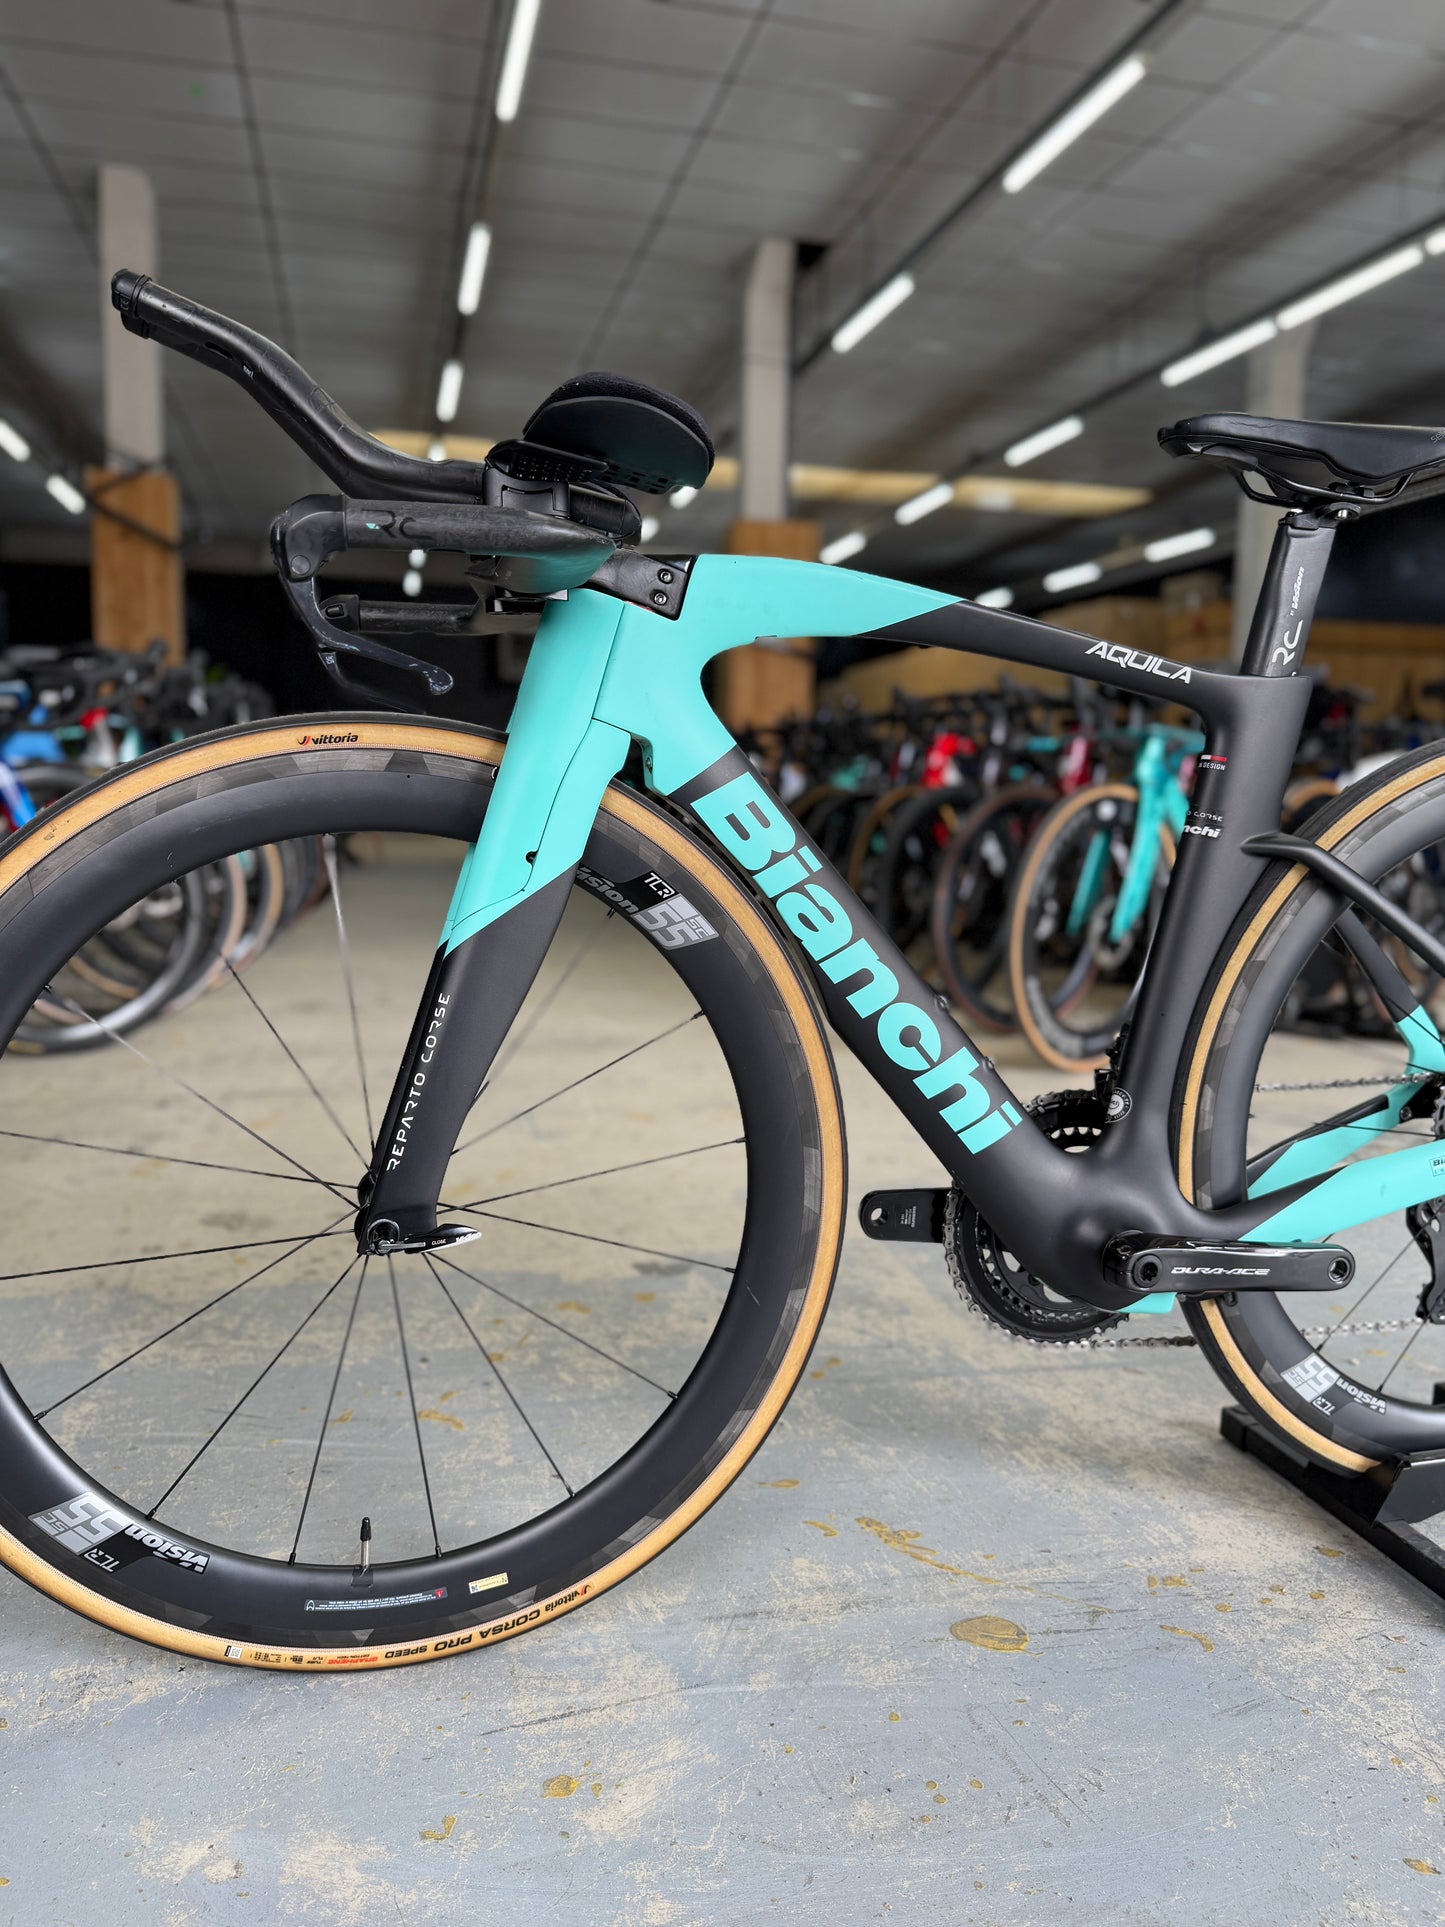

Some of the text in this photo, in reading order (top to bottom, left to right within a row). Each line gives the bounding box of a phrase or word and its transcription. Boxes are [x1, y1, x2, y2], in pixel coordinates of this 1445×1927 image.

[361, 508, 434, 541] RC
[1271, 619, 1303, 666] RC
[1084, 641, 1192, 684] AQUILA
[312, 732, 359, 745] vittoria
[1202, 761, 1226, 771] DESIGN
[644, 872, 676, 899] TLR
[633, 902, 699, 948] 55
[686, 919, 709, 939] SC
[690, 771, 1024, 1155] Bianchi
[386, 992, 451, 1172] REPARTO CORSE
[1170, 1266, 1271, 1276] DURA-ACE
[1294, 1354, 1341, 1394] 55
[1311, 1396, 1336, 1416] TLR
[40, 1512, 69, 1533] SC
[51, 1493, 133, 1544] 55
[83, 1547, 120, 1574] TLR
[384, 1588, 581, 1659] vittoria CORSA PRO SPEED
[327, 1656, 379, 1665] GRAPHENE
